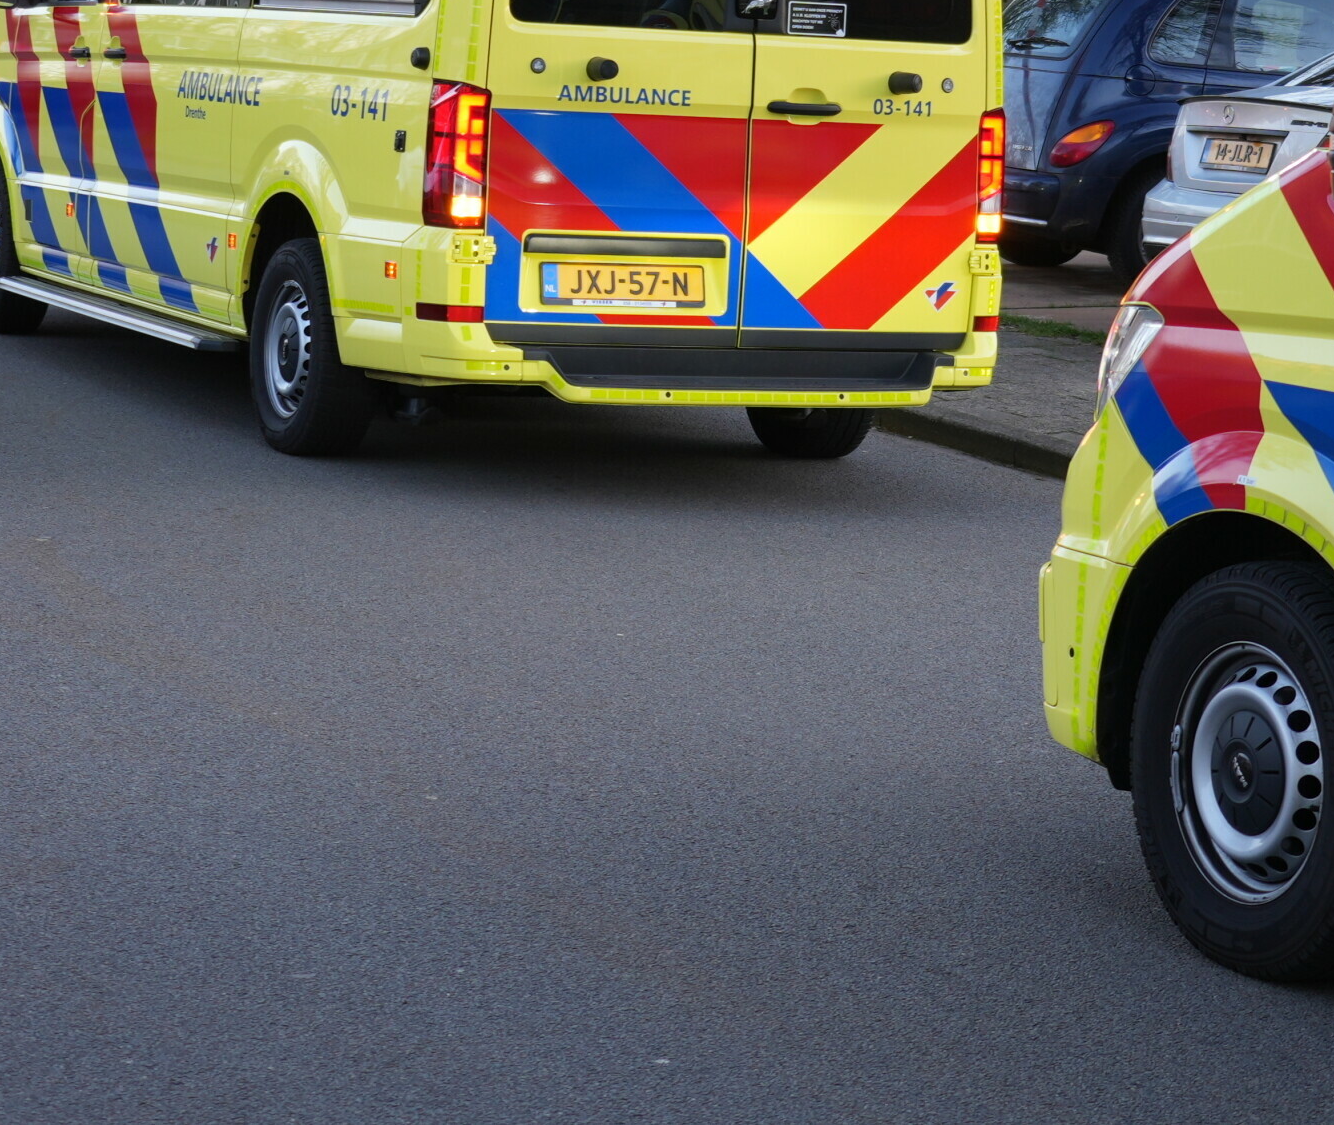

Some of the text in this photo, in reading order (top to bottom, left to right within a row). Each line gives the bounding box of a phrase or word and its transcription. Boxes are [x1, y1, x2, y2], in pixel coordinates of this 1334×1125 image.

[177, 71, 263, 106] AMBULANCE
[557, 85, 691, 106] AMBULANCE
[185, 105, 206, 120] Drenthe
[331, 84, 389, 121] 03-141
[873, 98, 932, 117] 03-141
[1215, 143, 1264, 164] 14-JLR-1
[545, 284, 557, 293] NL
[570, 269, 689, 296] JXJ-57-N
